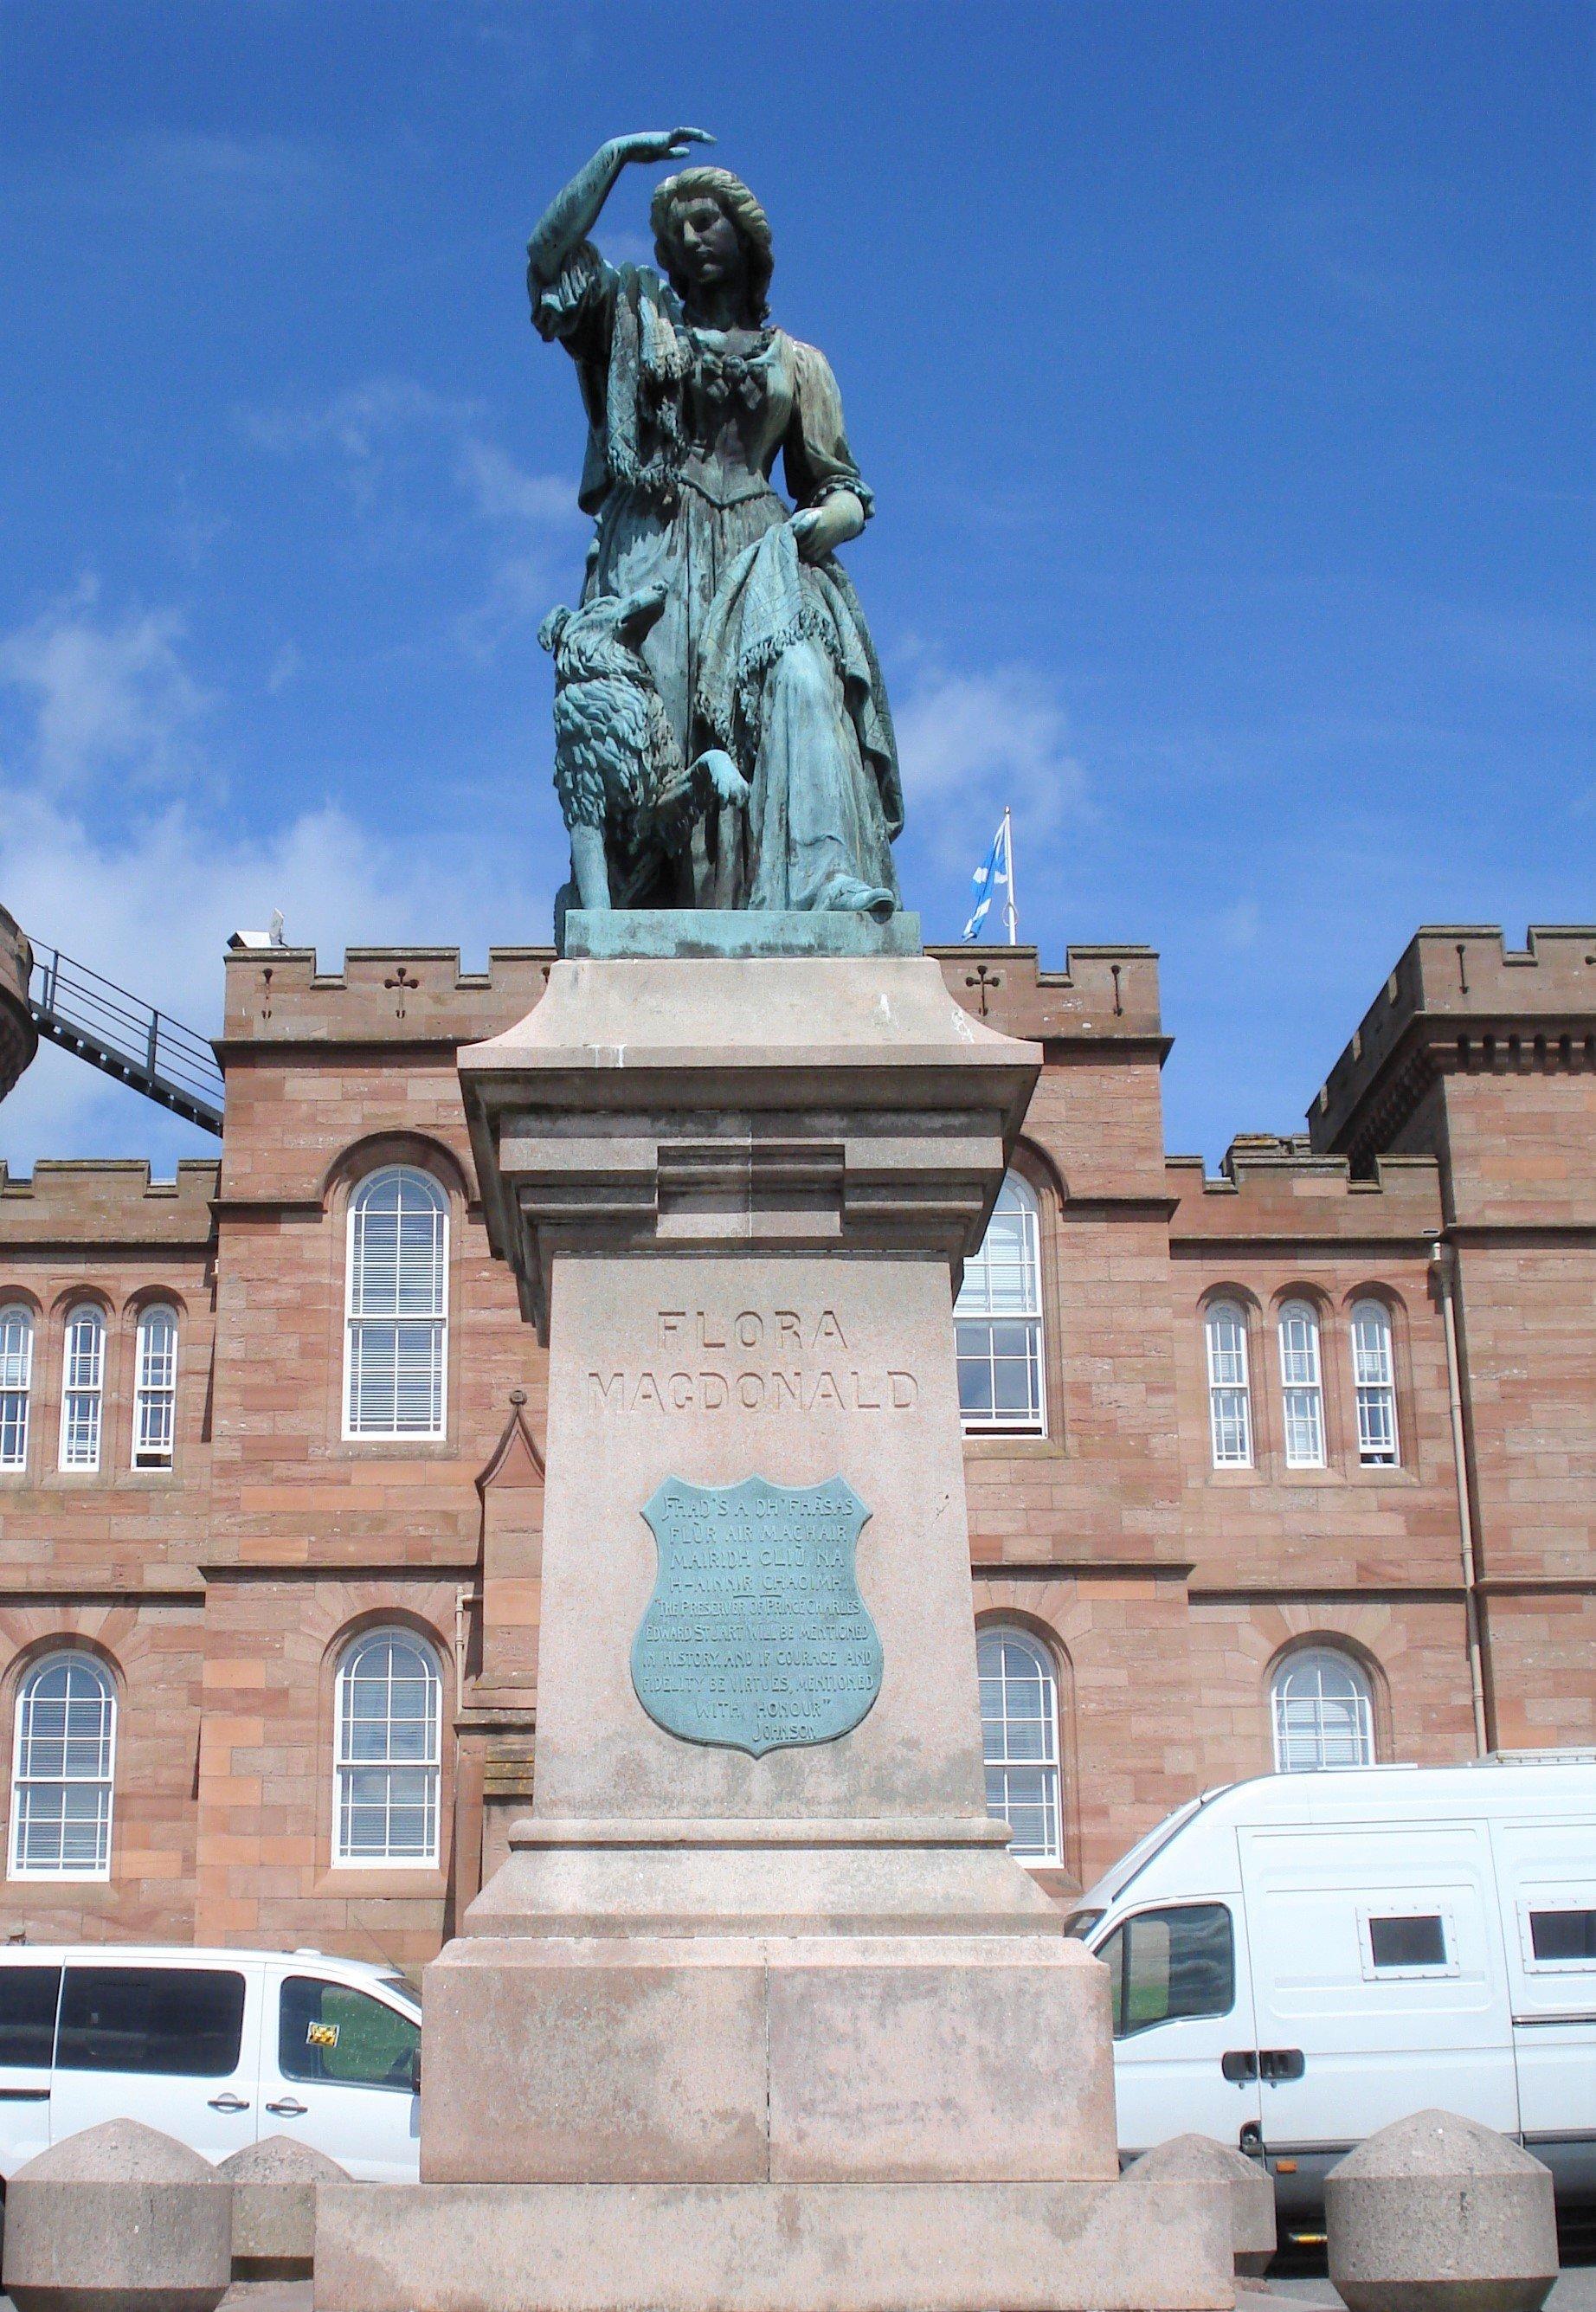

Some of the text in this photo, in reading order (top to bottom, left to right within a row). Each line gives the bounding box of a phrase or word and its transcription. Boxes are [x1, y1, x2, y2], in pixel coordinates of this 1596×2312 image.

[658, 1311, 848, 1349] FLORA
[734, 1499, 749, 1517] A
[725, 1526, 753, 1543] AIR
[760, 1526, 848, 1543] MACHAIR
[670, 1550, 751, 1569] MAIRIDH
[816, 1549, 845, 1568] NA
[681, 1600, 745, 1617] PRESERVER
[748, 1600, 763, 1616] OF
[766, 1600, 805, 1616] PRINCE
[807, 1599, 860, 1617] CHARLES
[647, 1624, 869, 1642] EDWARD STUART WILL BE MENTIONED
[724, 1651, 752, 1668] AND
[759, 1650, 770, 1667] IF
[776, 1650, 837, 1667] COURAGE
[844, 1649, 872, 1667] AND
[642, 1677, 705, 1693] FIDELITY
[709, 1677, 726, 1693] BE
[795, 1675, 874, 1693] MENTIONED
[695, 1698, 742, 1719] WITH
[751, 1723, 817, 1742] JOHNSON
